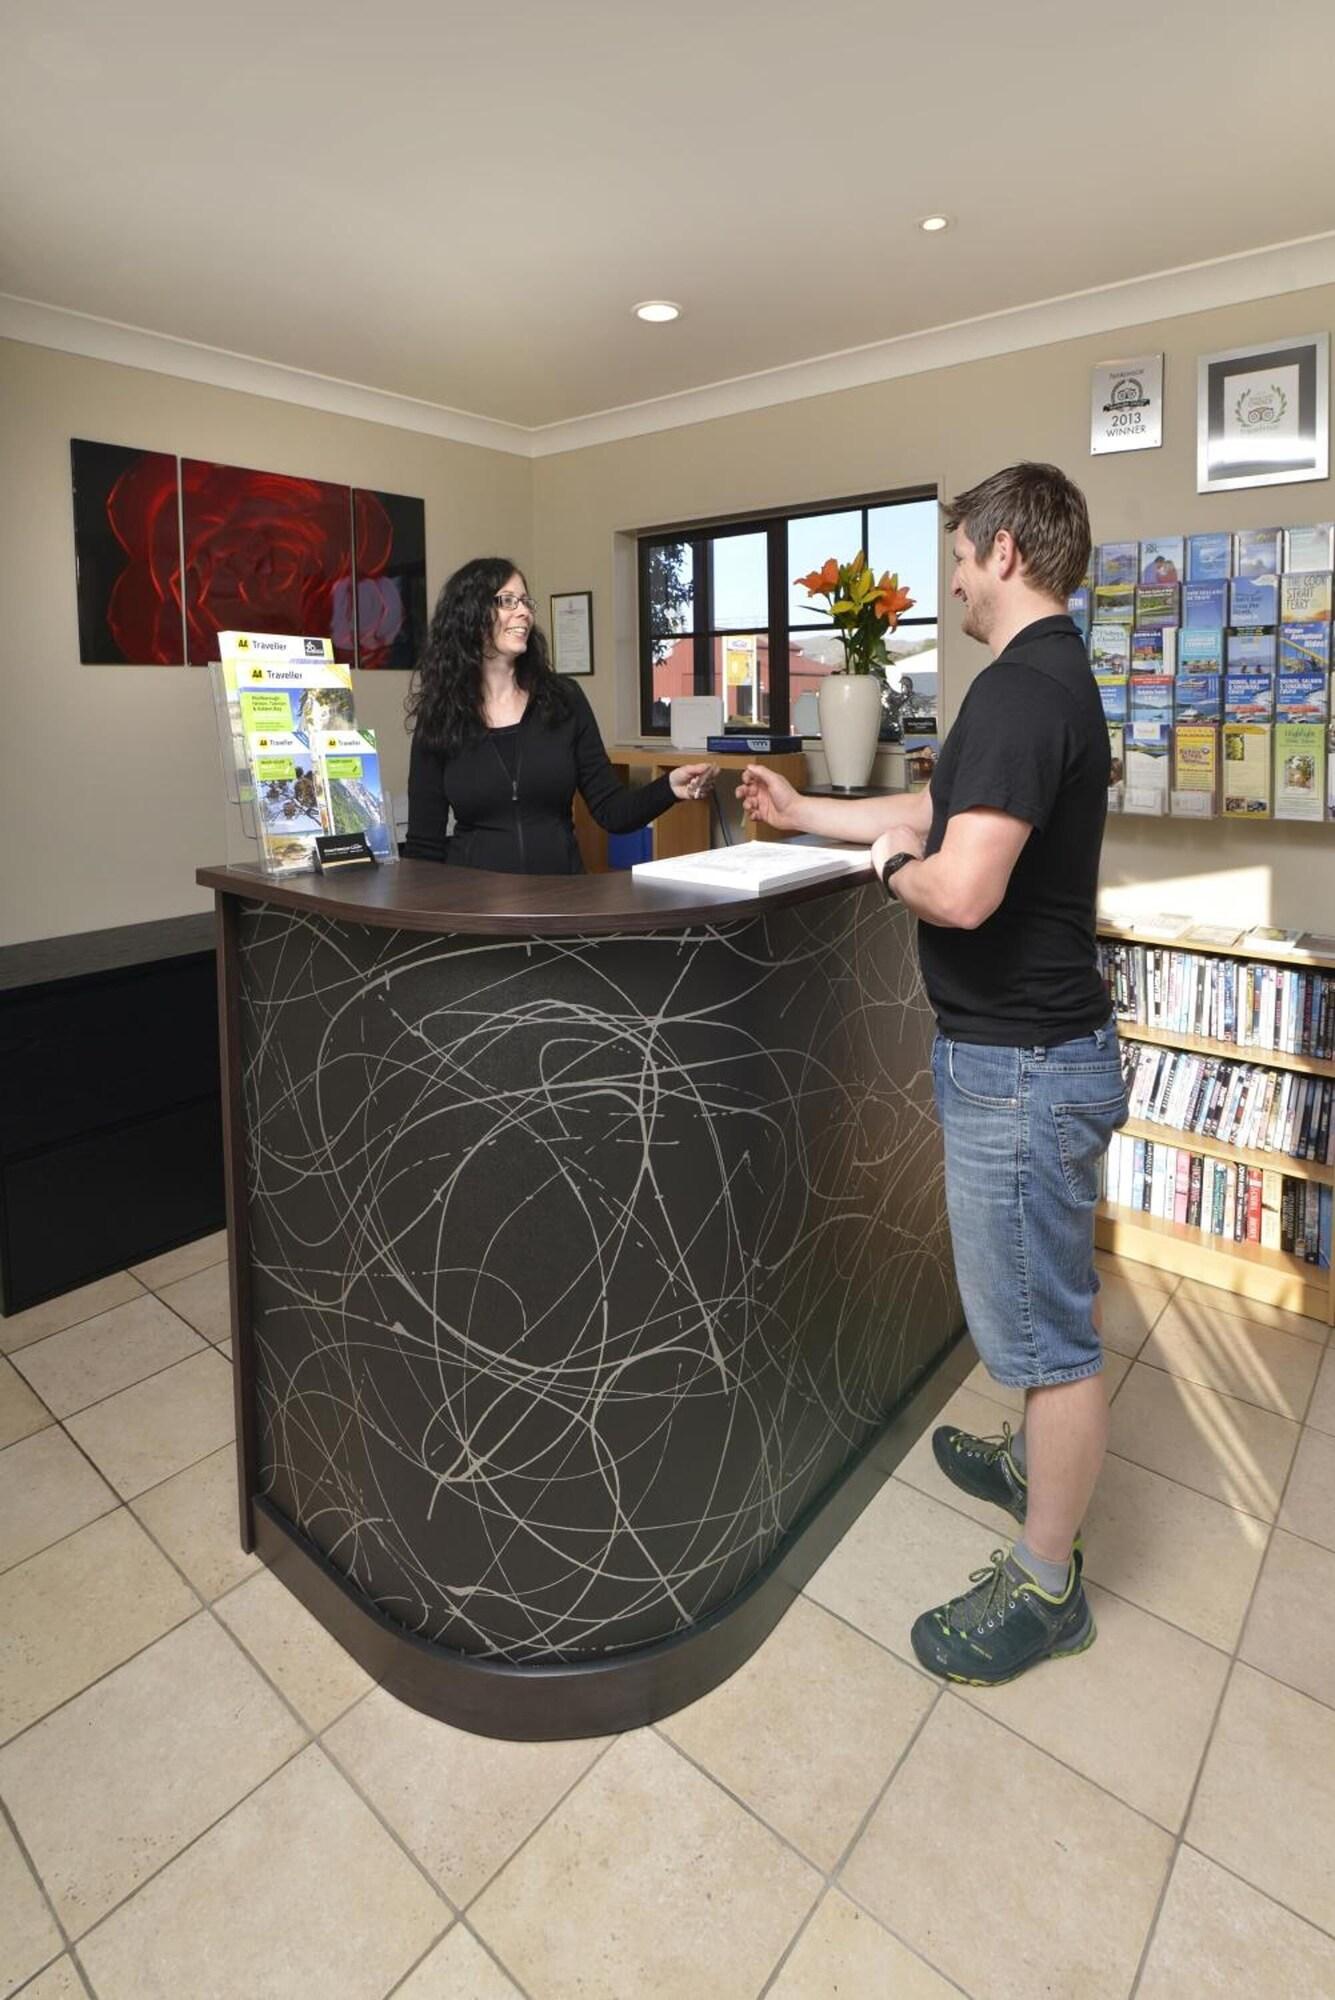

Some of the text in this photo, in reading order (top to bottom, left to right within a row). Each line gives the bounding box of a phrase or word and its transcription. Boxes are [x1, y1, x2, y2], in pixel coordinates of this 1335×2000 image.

[1111, 412, 1142, 427] 2013
[1106, 425, 1146, 437] WINNER
[1286, 598, 1311, 610] FERRY
[238, 640, 287, 650] AA Traveller
[252, 669, 303, 680] AA Traveller
